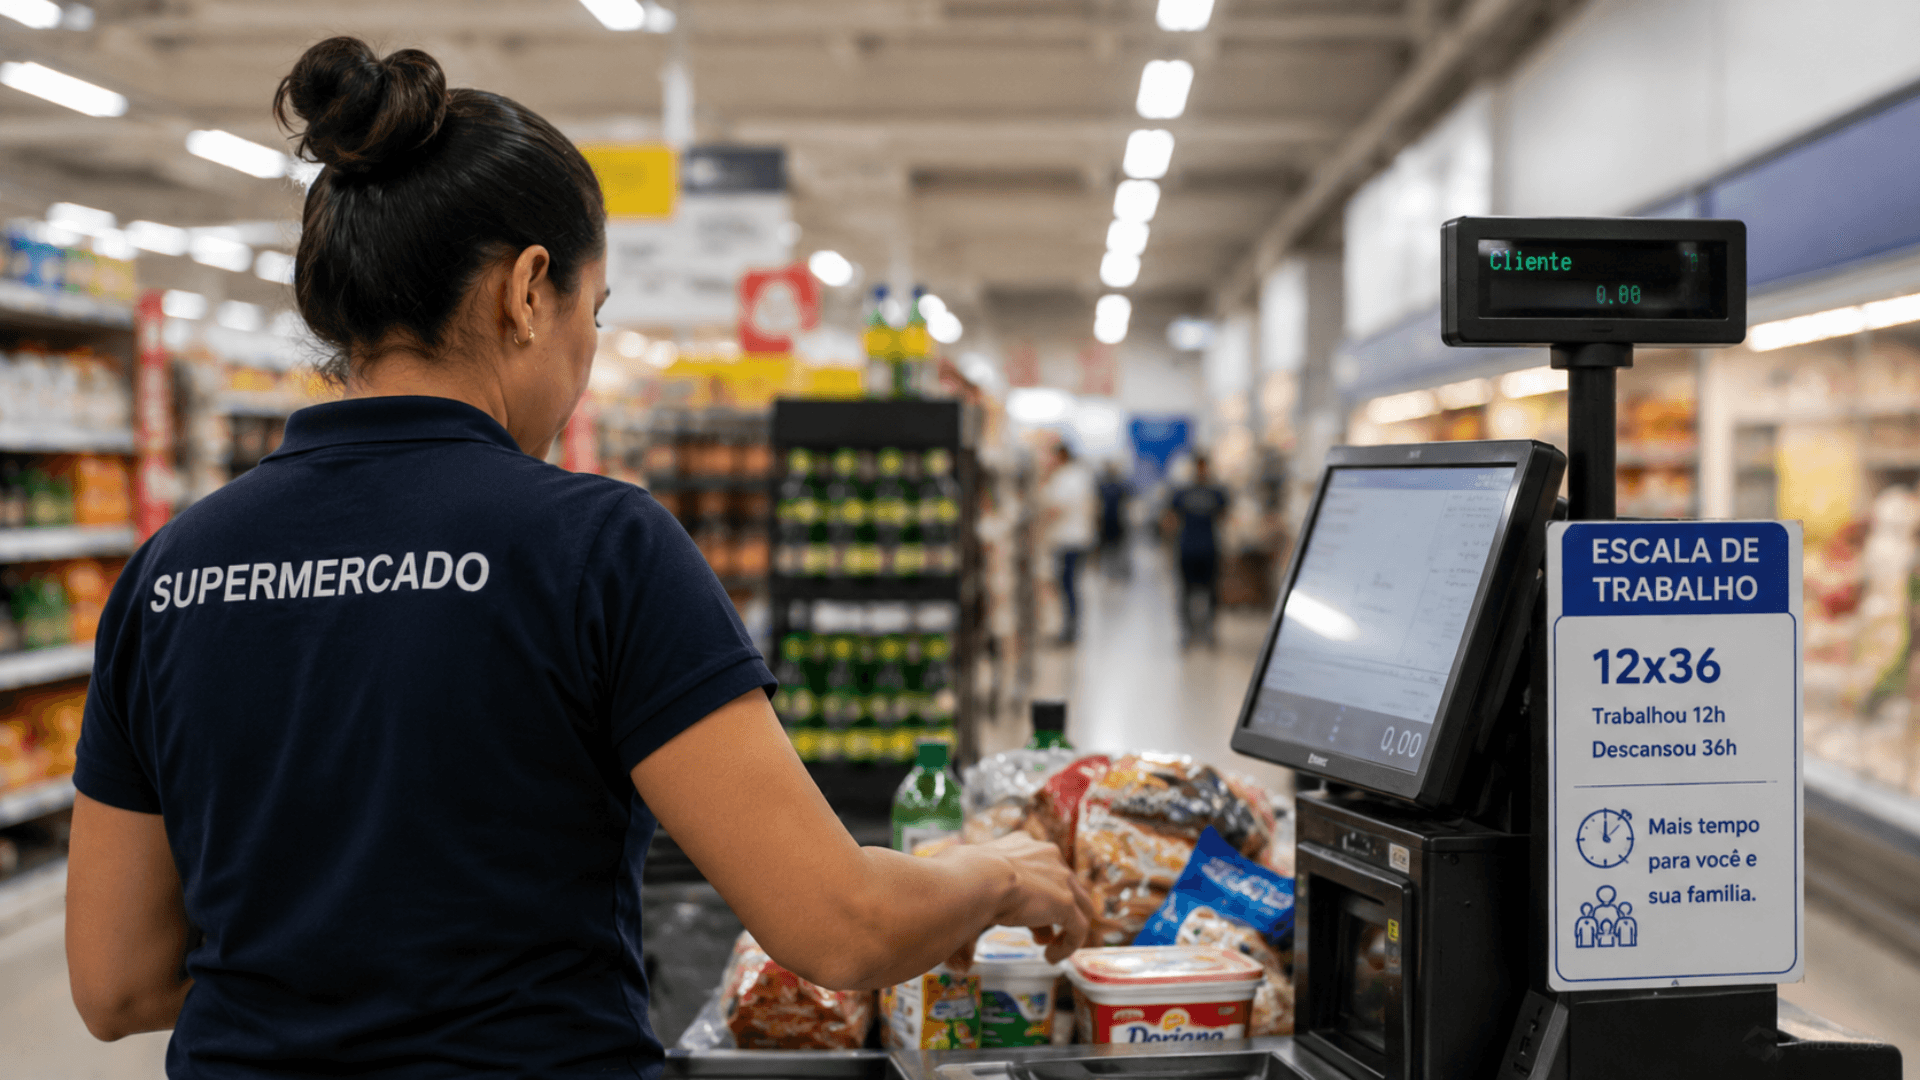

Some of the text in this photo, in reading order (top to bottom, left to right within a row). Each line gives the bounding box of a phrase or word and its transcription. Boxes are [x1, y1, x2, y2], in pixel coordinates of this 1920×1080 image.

[1489, 249, 1573, 272] Cliente
[1596, 284, 1641, 306] 0.00
[1592, 537, 1760, 564] ESCALA DE
[150, 551, 490, 613] SUPERMERCADO
[1592, 575, 1758, 602] TRABALHO
[1592, 646, 1722, 685] 12x36
[1591, 705, 1726, 725] Trabalhou 12h
[1380, 726, 1422, 758] 0,00
[1592, 738, 1737, 759] Descansou 36h
[1648, 816, 1760, 838] Mais tempo
[1648, 848, 1758, 875] para você e
[1648, 890, 1682, 905] sua
